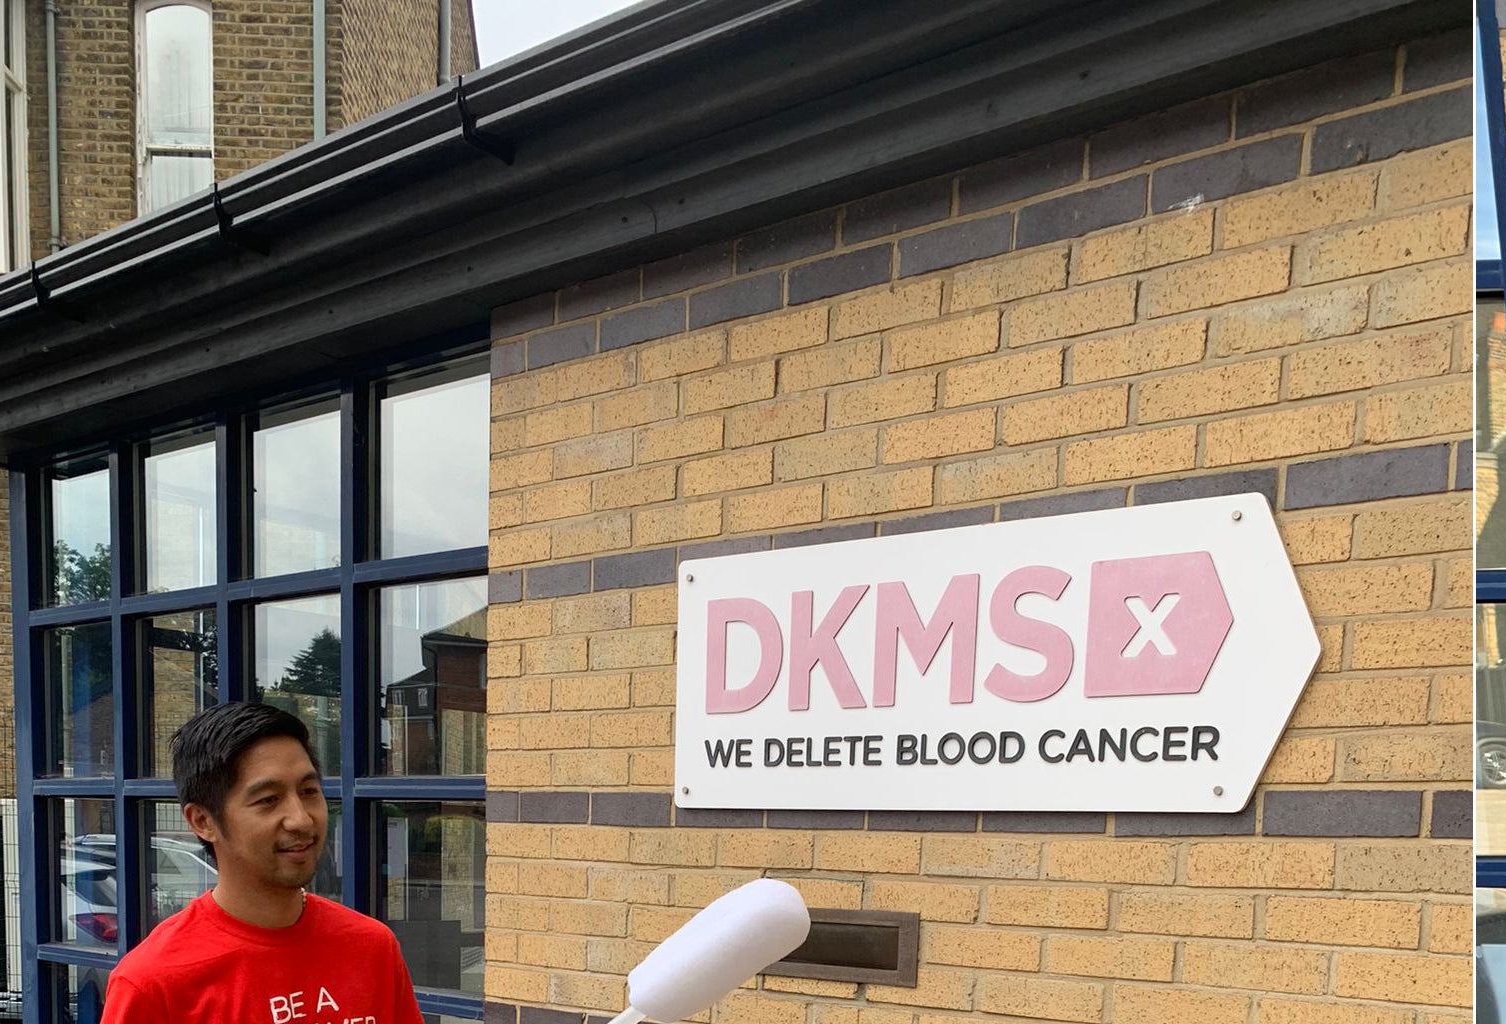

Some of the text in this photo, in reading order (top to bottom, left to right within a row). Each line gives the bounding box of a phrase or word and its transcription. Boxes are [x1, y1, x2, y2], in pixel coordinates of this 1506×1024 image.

[705, 565, 1075, 714] DKMS
[704, 725, 1220, 768] WE DELETE BLOOD CANCER
[269, 987, 340, 1024] BE A
